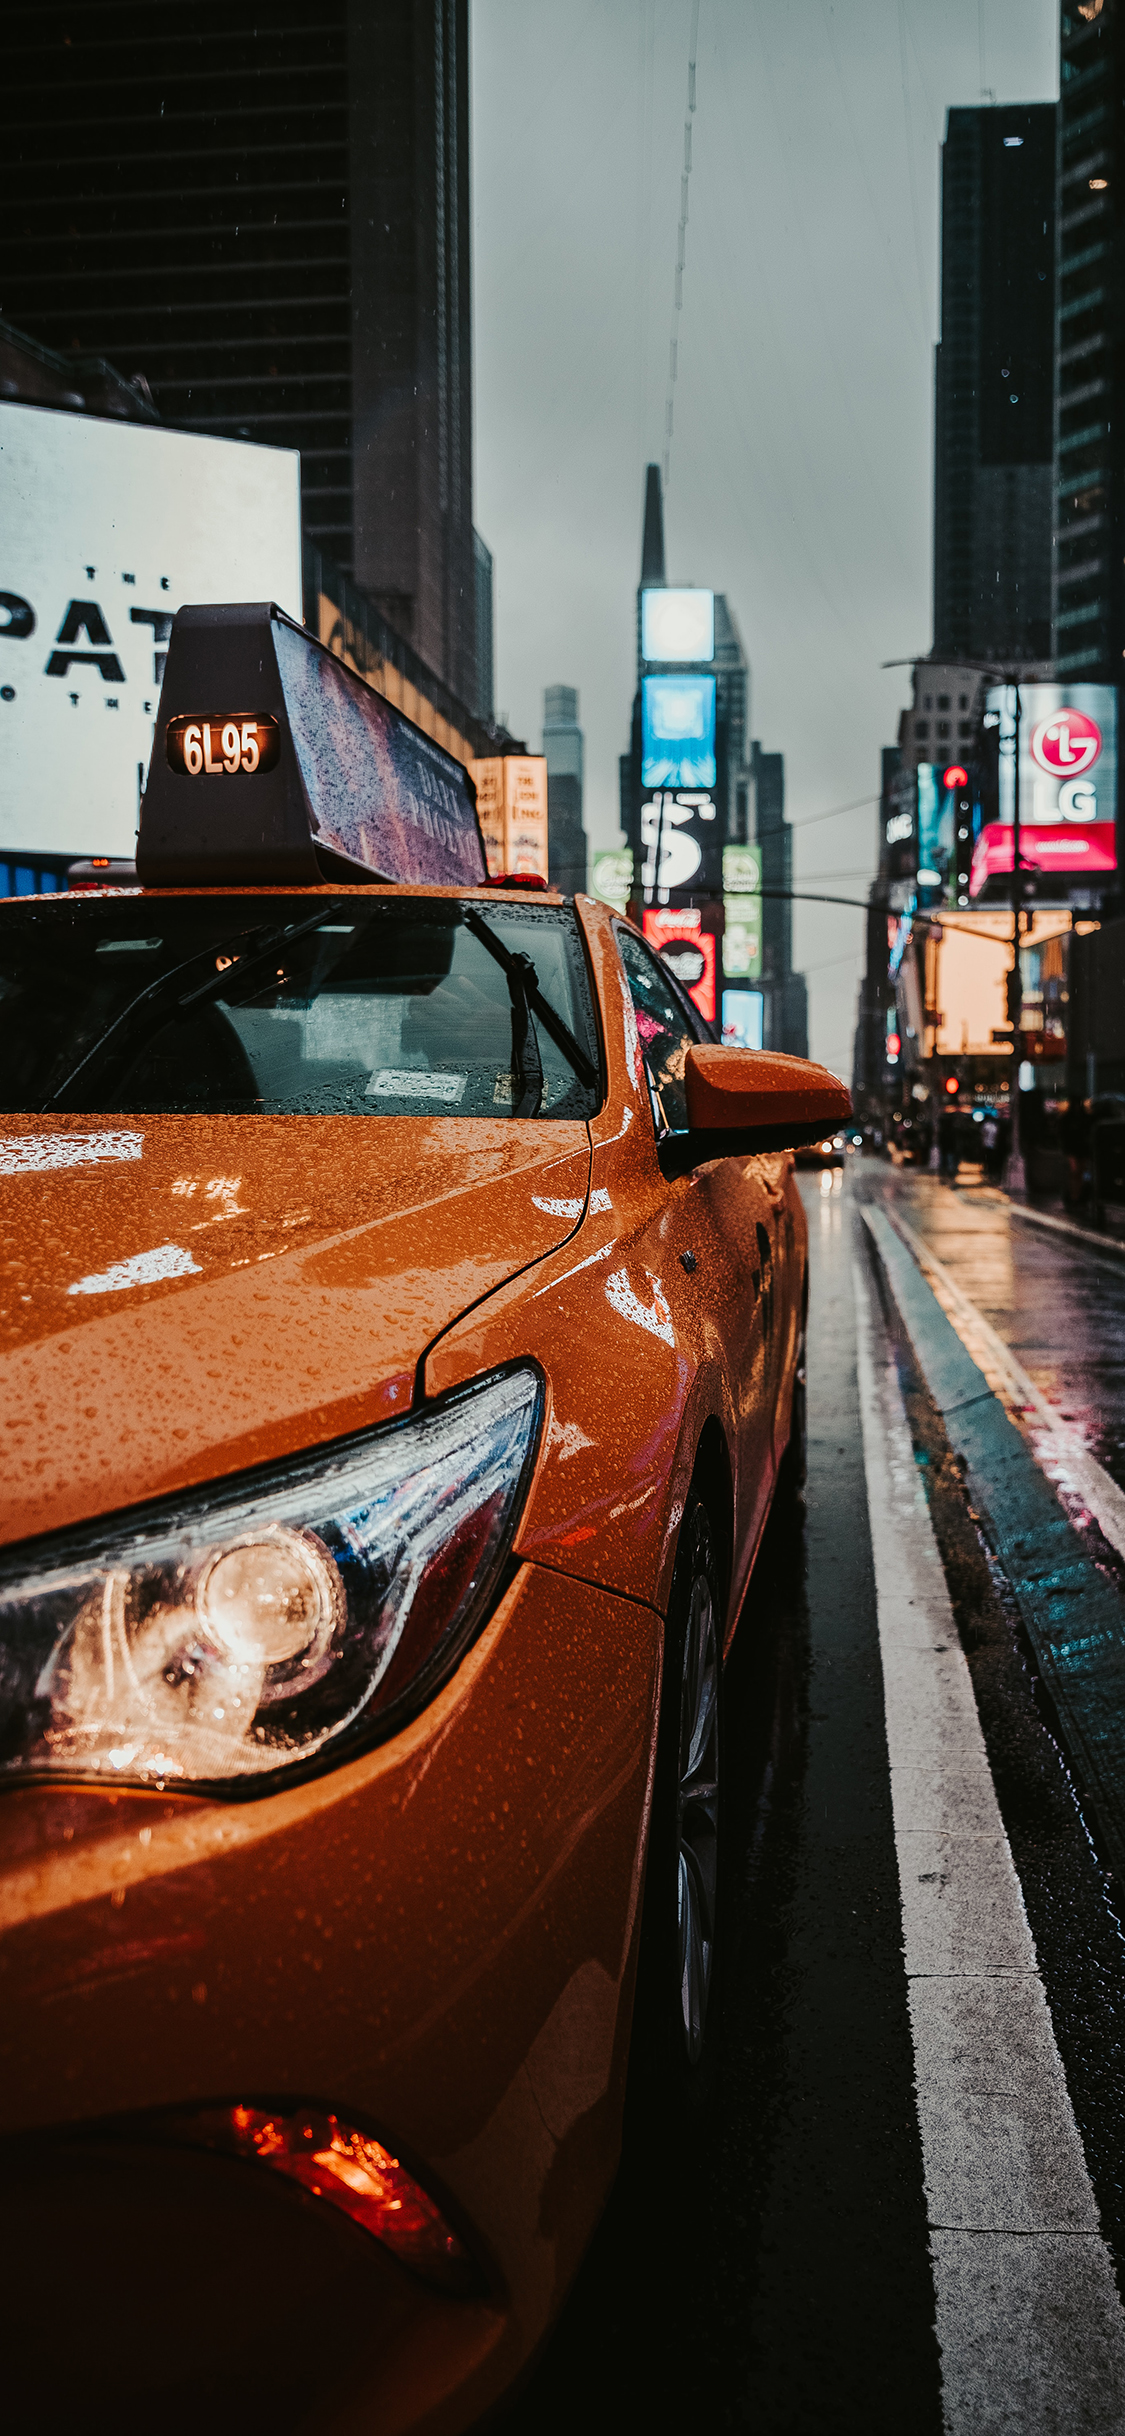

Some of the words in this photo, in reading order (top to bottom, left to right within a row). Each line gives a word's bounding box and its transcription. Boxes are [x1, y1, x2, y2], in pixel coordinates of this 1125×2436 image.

[84, 565, 170, 591] THE
[69, 692, 153, 715] THE
[183, 721, 260, 775] 6L95
[1033, 779, 1097, 822] LG
